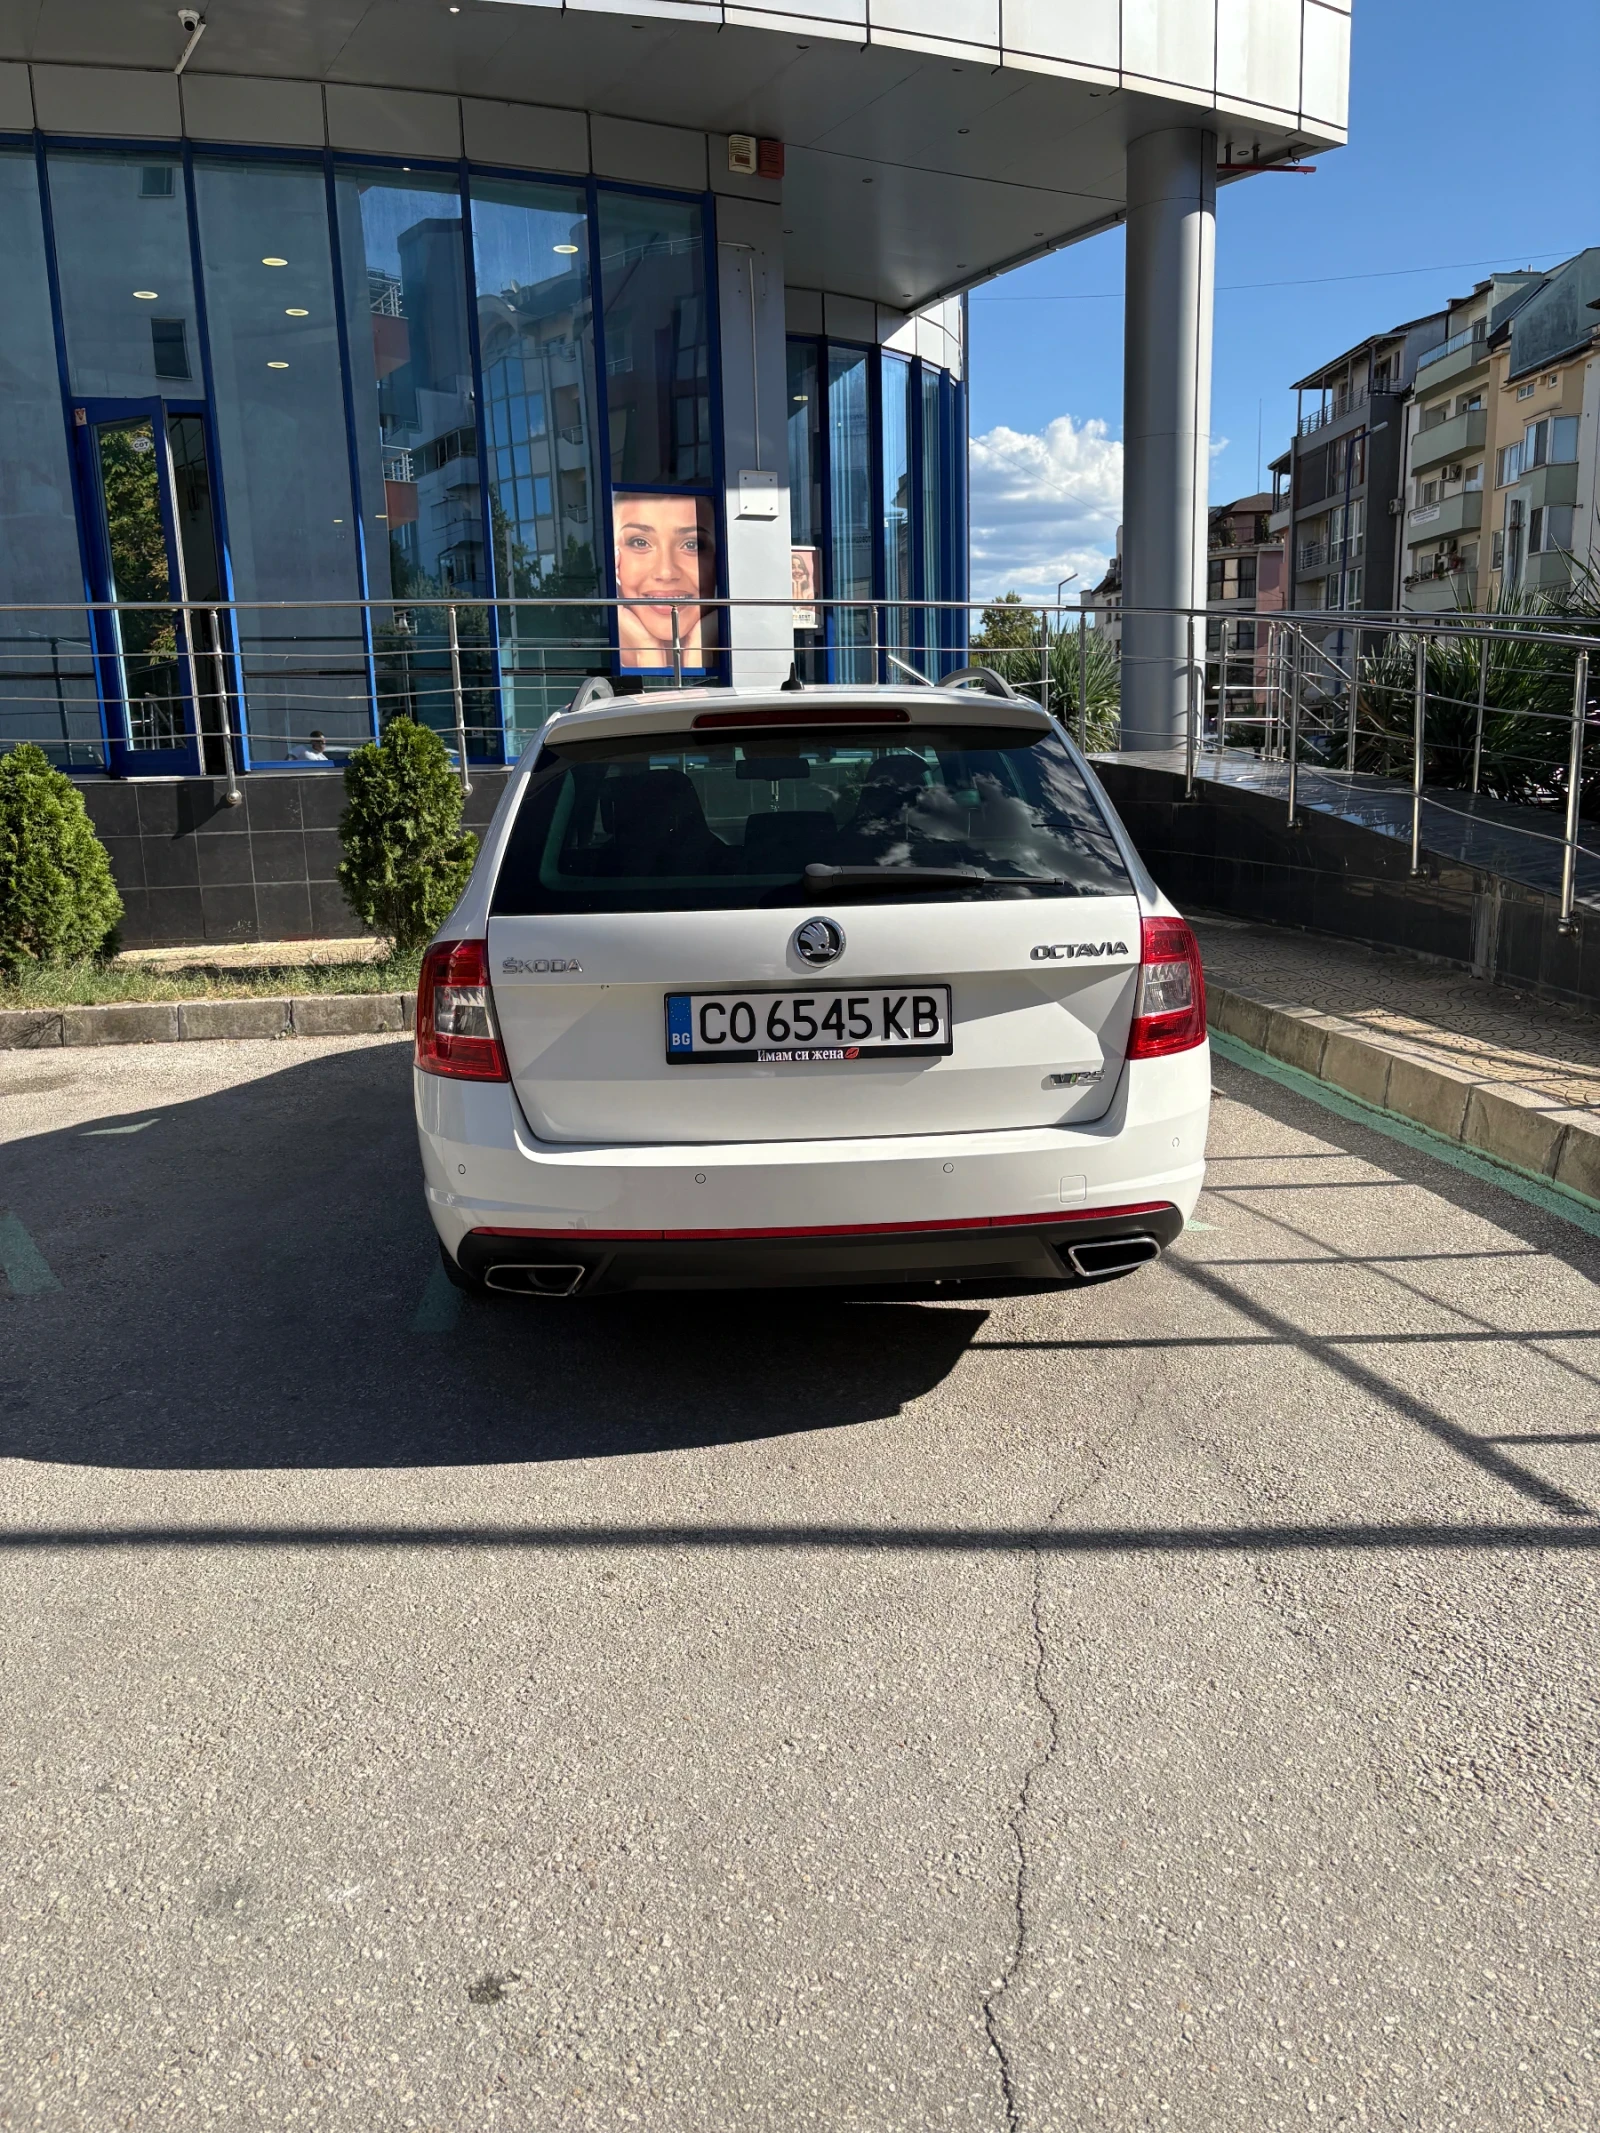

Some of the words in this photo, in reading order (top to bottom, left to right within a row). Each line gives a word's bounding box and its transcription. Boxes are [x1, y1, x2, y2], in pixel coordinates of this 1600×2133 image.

[1030, 941, 1129, 961] OCTAVIA
[502, 957, 583, 974] ŠKODA
[700, 1001, 756, 1044] CO
[766, 998, 873, 1042] 6545
[883, 996, 940, 1039] KB
[672, 1033, 691, 1046] BG
[757, 1049, 792, 1062] Имам
[795, 1050, 809, 1061] си
[812, 1049, 844, 1060] жена
